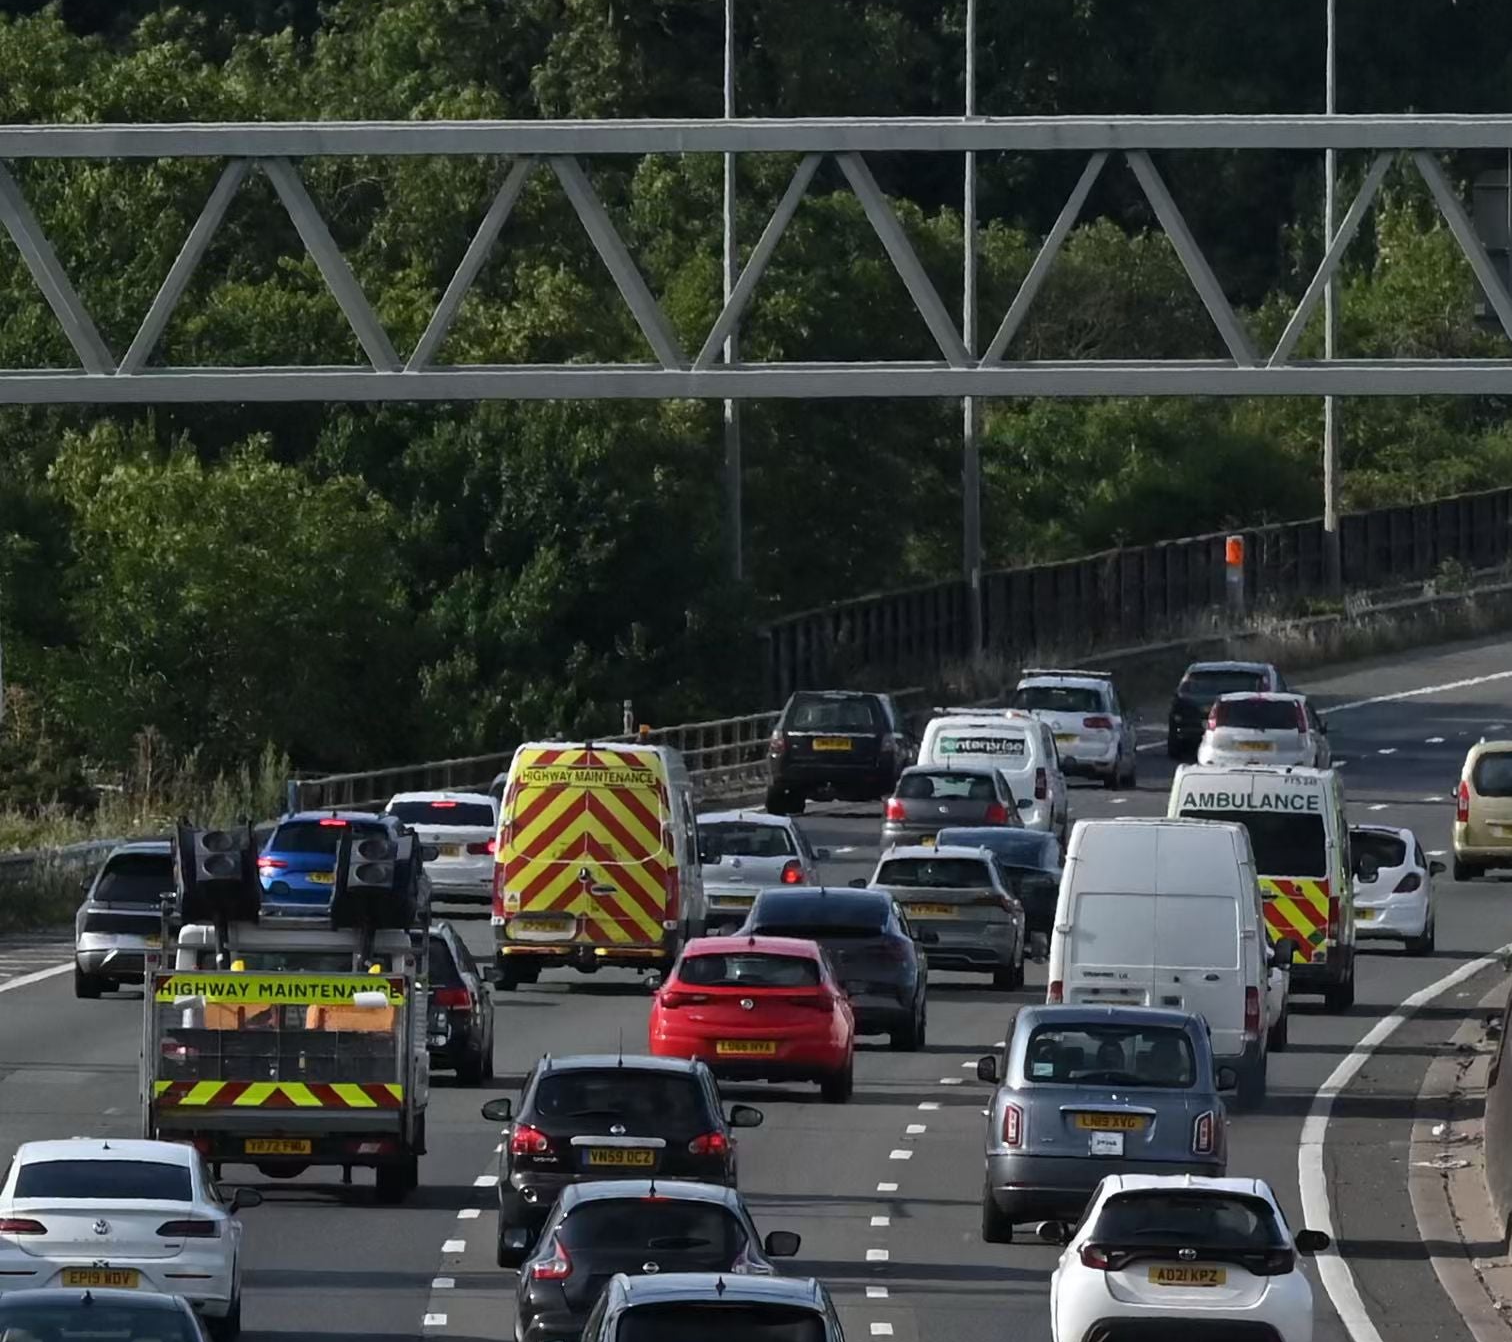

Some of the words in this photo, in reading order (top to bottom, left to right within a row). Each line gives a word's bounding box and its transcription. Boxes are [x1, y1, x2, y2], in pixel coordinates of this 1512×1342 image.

[522, 769, 574, 781] HIGHWAY
[576, 769, 655, 783] MAINTENANCE
[1182, 791, 1319, 810] AMBULANCE
[160, 981, 250, 997] HIGHWAY
[257, 981, 401, 999] MAINTENANCE
